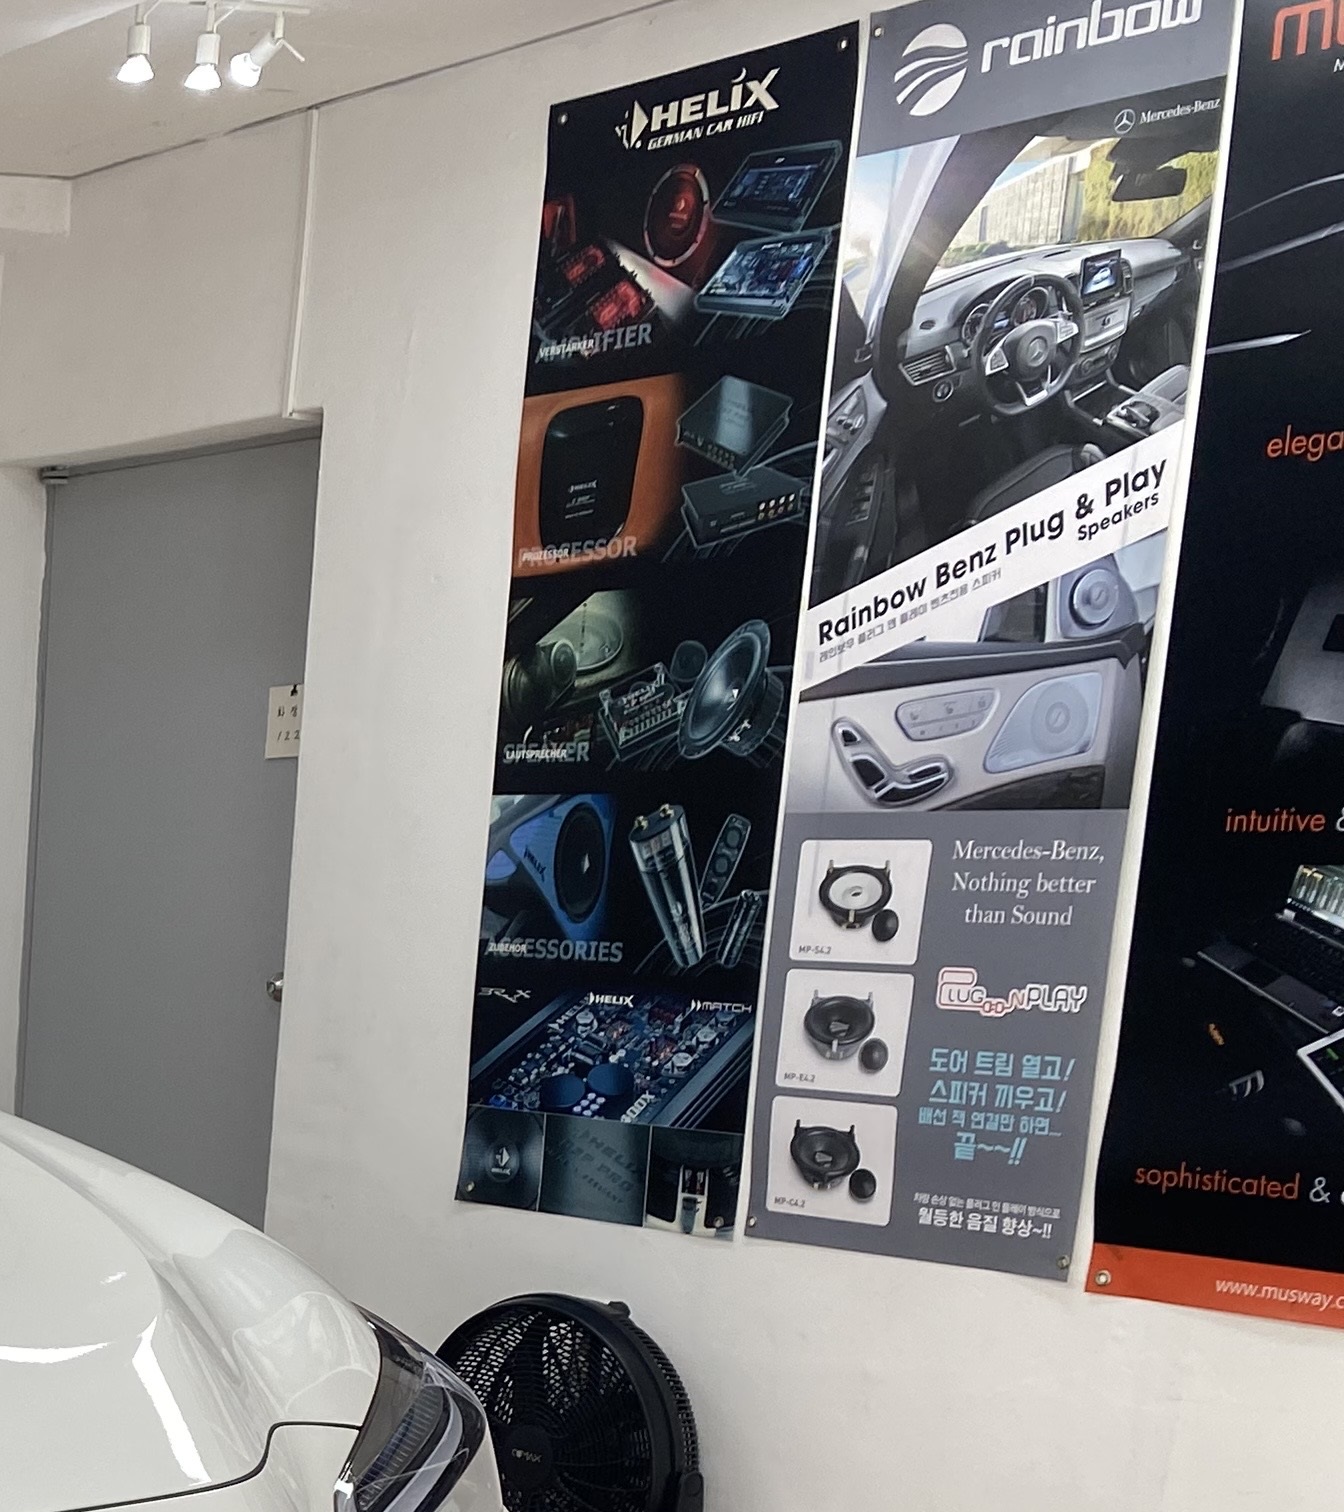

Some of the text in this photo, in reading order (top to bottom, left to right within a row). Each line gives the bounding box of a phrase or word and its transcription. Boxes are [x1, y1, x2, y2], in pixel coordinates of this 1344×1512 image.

[980, 0, 1203, 74] rainbow
[650, 67, 781, 132] HELIX
[1139, 98, 1221, 125] Mercedes-Benz
[647, 110, 765, 151] GERMAN CAR HIFI
[1077, 492, 1160, 541] Speakers
[818, 459, 1168, 646] Rainbow Benz Plug & Play
[972, 566, 1002, 592] 스피커
[1225, 806, 1326, 833] intuitive
[951, 839, 1105, 864] Mercedes-Benz,
[951, 871, 1097, 899] Nothing better
[964, 903, 1074, 926] than Sound
[594, 993, 635, 1008] HELIX
[701, 1001, 753, 1014] MATCH
[928, 1046, 1076, 1082] 도어 트림 열고!
[928, 1078, 1067, 1114] 스피커 끼우고!
[918, 1106, 947, 1126] 배선
[970, 1111, 1015, 1132] 연결만
[1134, 1161, 1331, 1204] sophisticated &
[917, 1206, 965, 1229] 월등한
[966, 1212, 1000, 1233] 음질
[1214, 1279, 1344, 1312] www.musway.c
